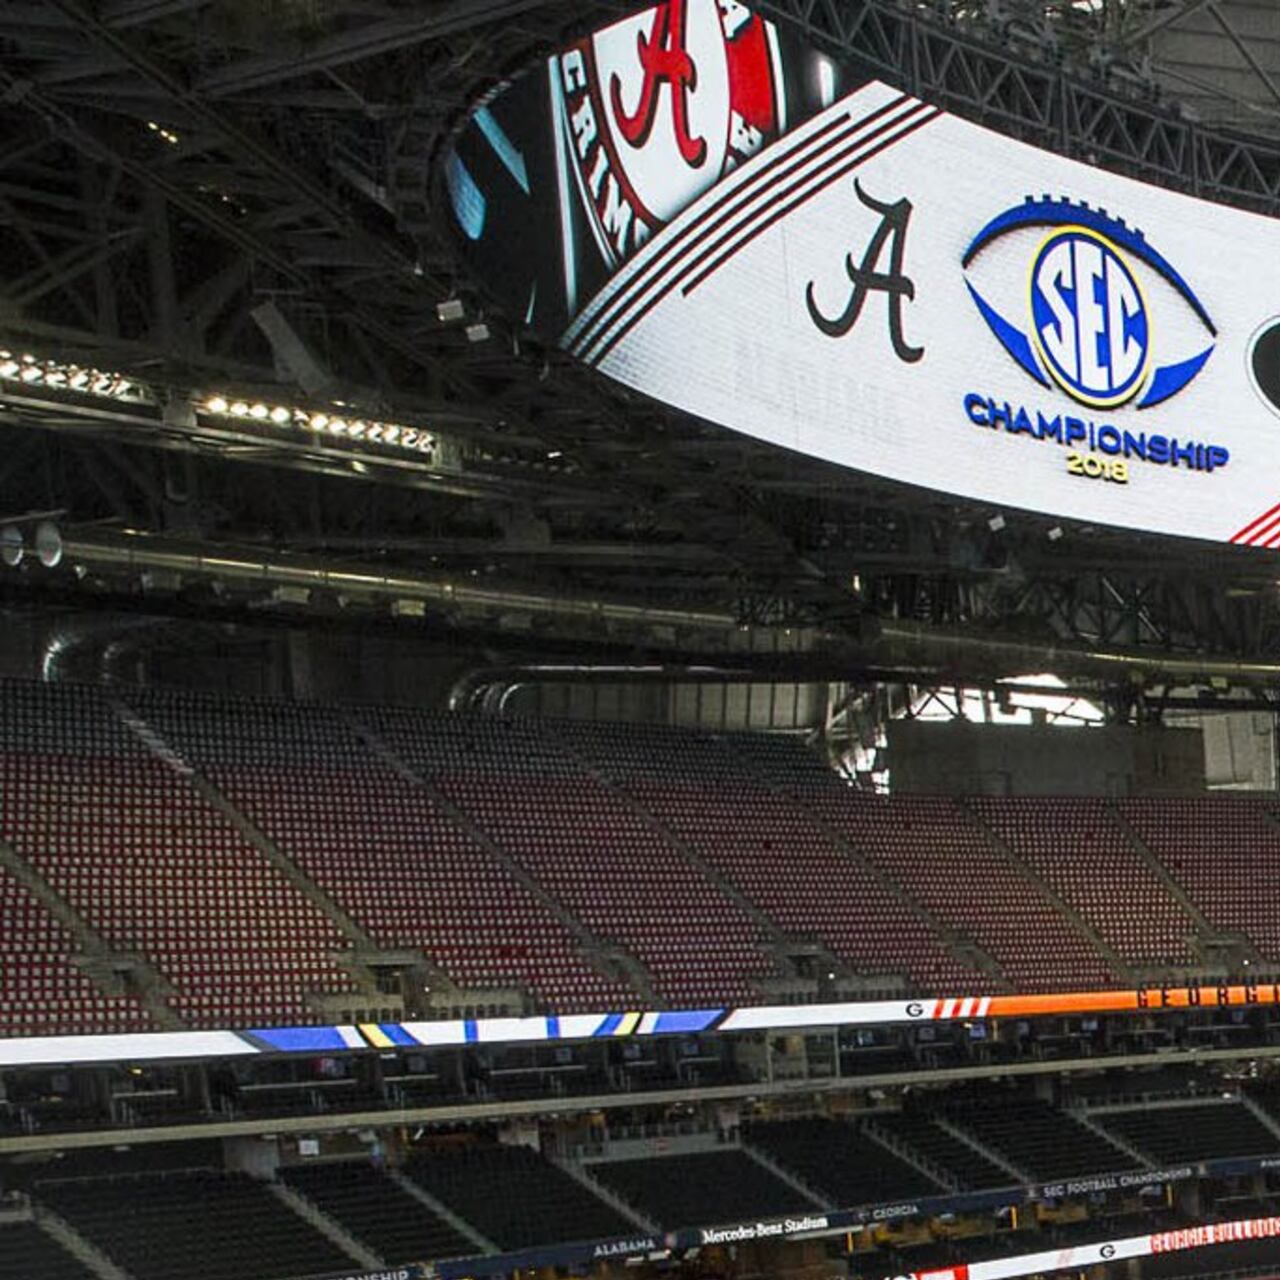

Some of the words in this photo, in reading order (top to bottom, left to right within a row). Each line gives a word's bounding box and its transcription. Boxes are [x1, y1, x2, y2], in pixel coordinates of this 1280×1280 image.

[807, 178, 924, 363] A
[1037, 236, 1146, 392] SEC
[962, 391, 1231, 474] CHAMPIONSHIP
[1066, 449, 1130, 484] 2018
[905, 1003, 924, 1018] G
[1043, 1183, 1066, 1198] SEC
[1067, 1176, 1118, 1196] FOOTBALL
[1120, 1168, 1192, 1187] CHAMPIONSHIP
[702, 1222, 782, 1245] Mercedes-Benz
[784, 1217, 828, 1234] Stadium
[593, 1239, 656, 1257] ALABAMA
[1100, 1244, 1116, 1259] G
